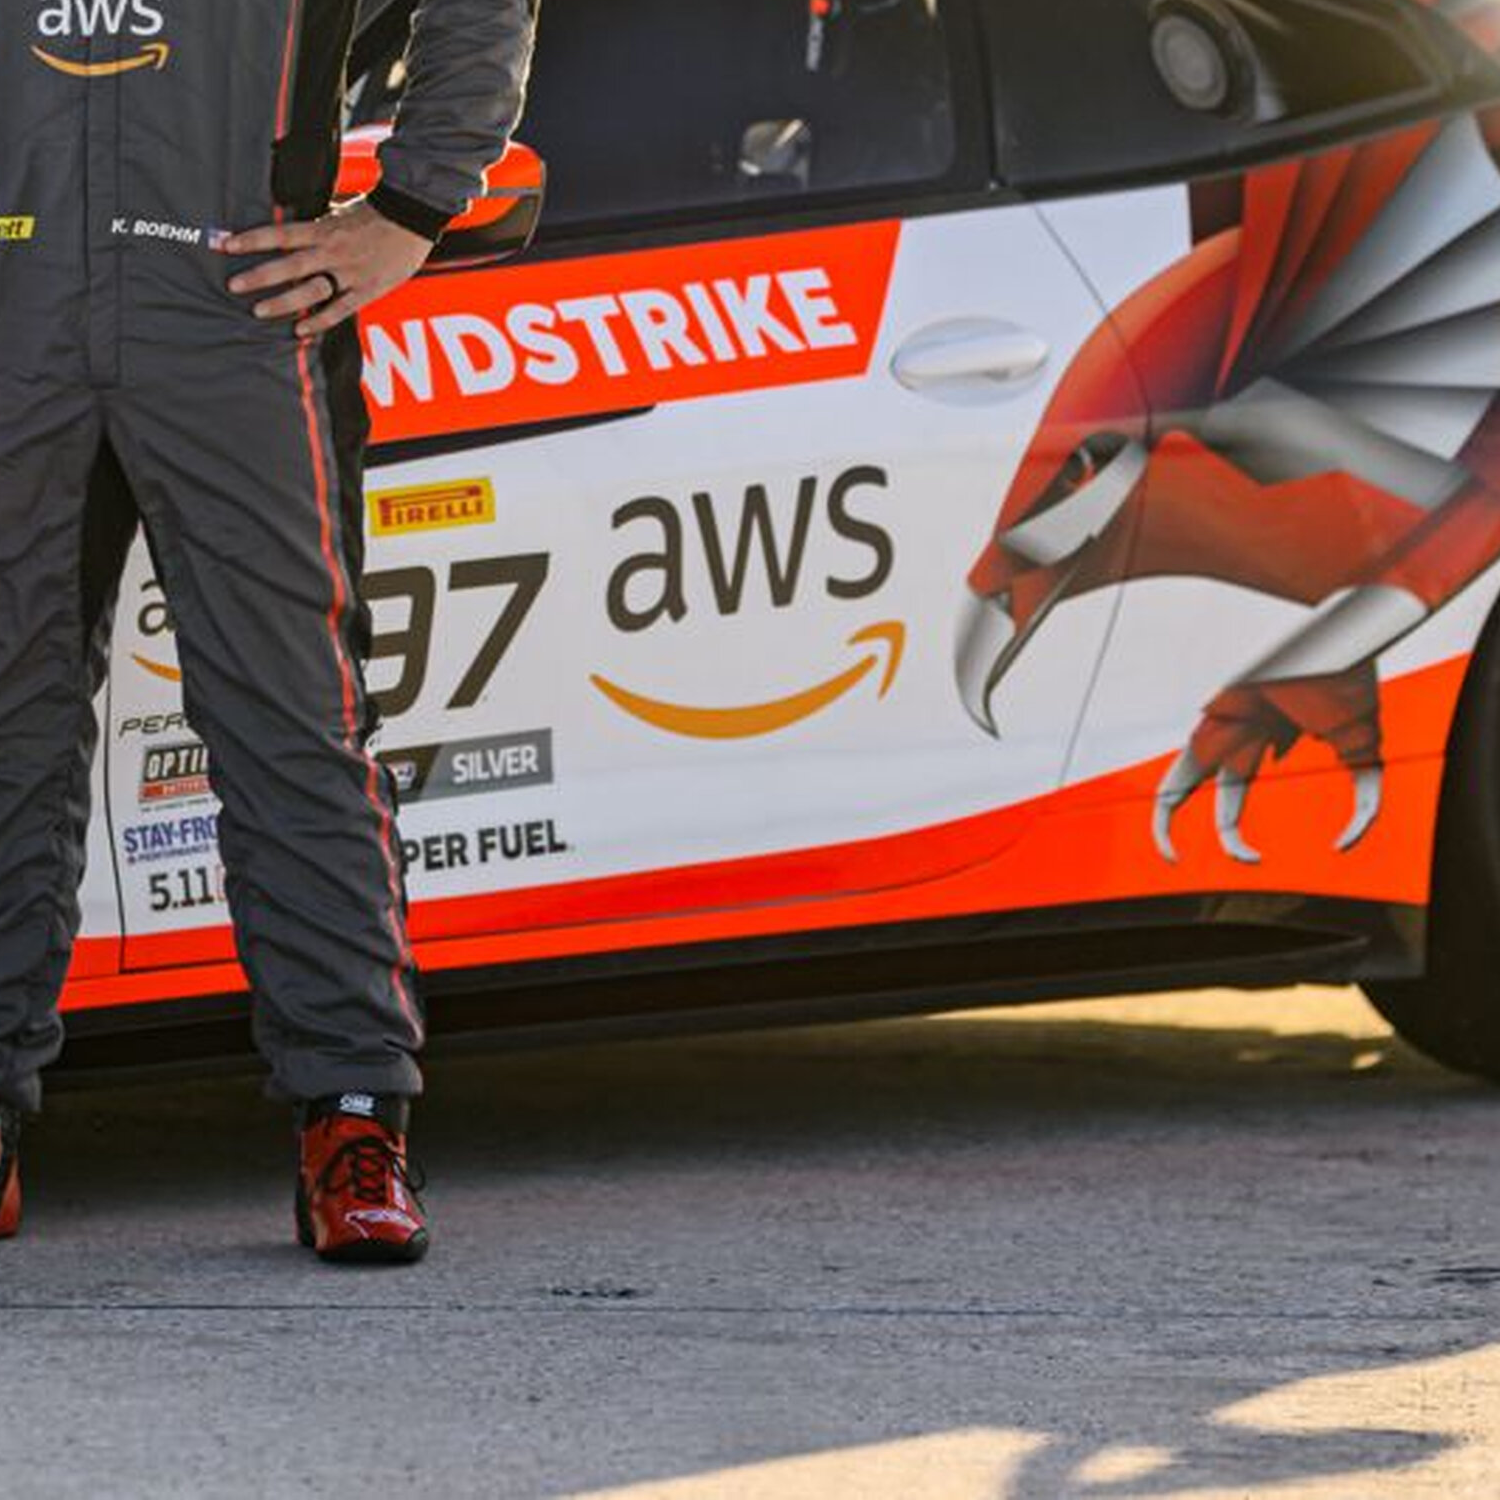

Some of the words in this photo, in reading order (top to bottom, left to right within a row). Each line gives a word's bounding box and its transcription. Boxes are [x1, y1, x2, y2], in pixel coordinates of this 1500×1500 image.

[112, 218, 128, 234] K.
[133, 220, 201, 243] BOEHM
[379, 484, 483, 527] PIRELLI
[605, 465, 894, 633] aws
[453, 745, 539, 783] SILVER
[478, 819, 567, 863] FUEL
[149, 866, 214, 910] 5.11
